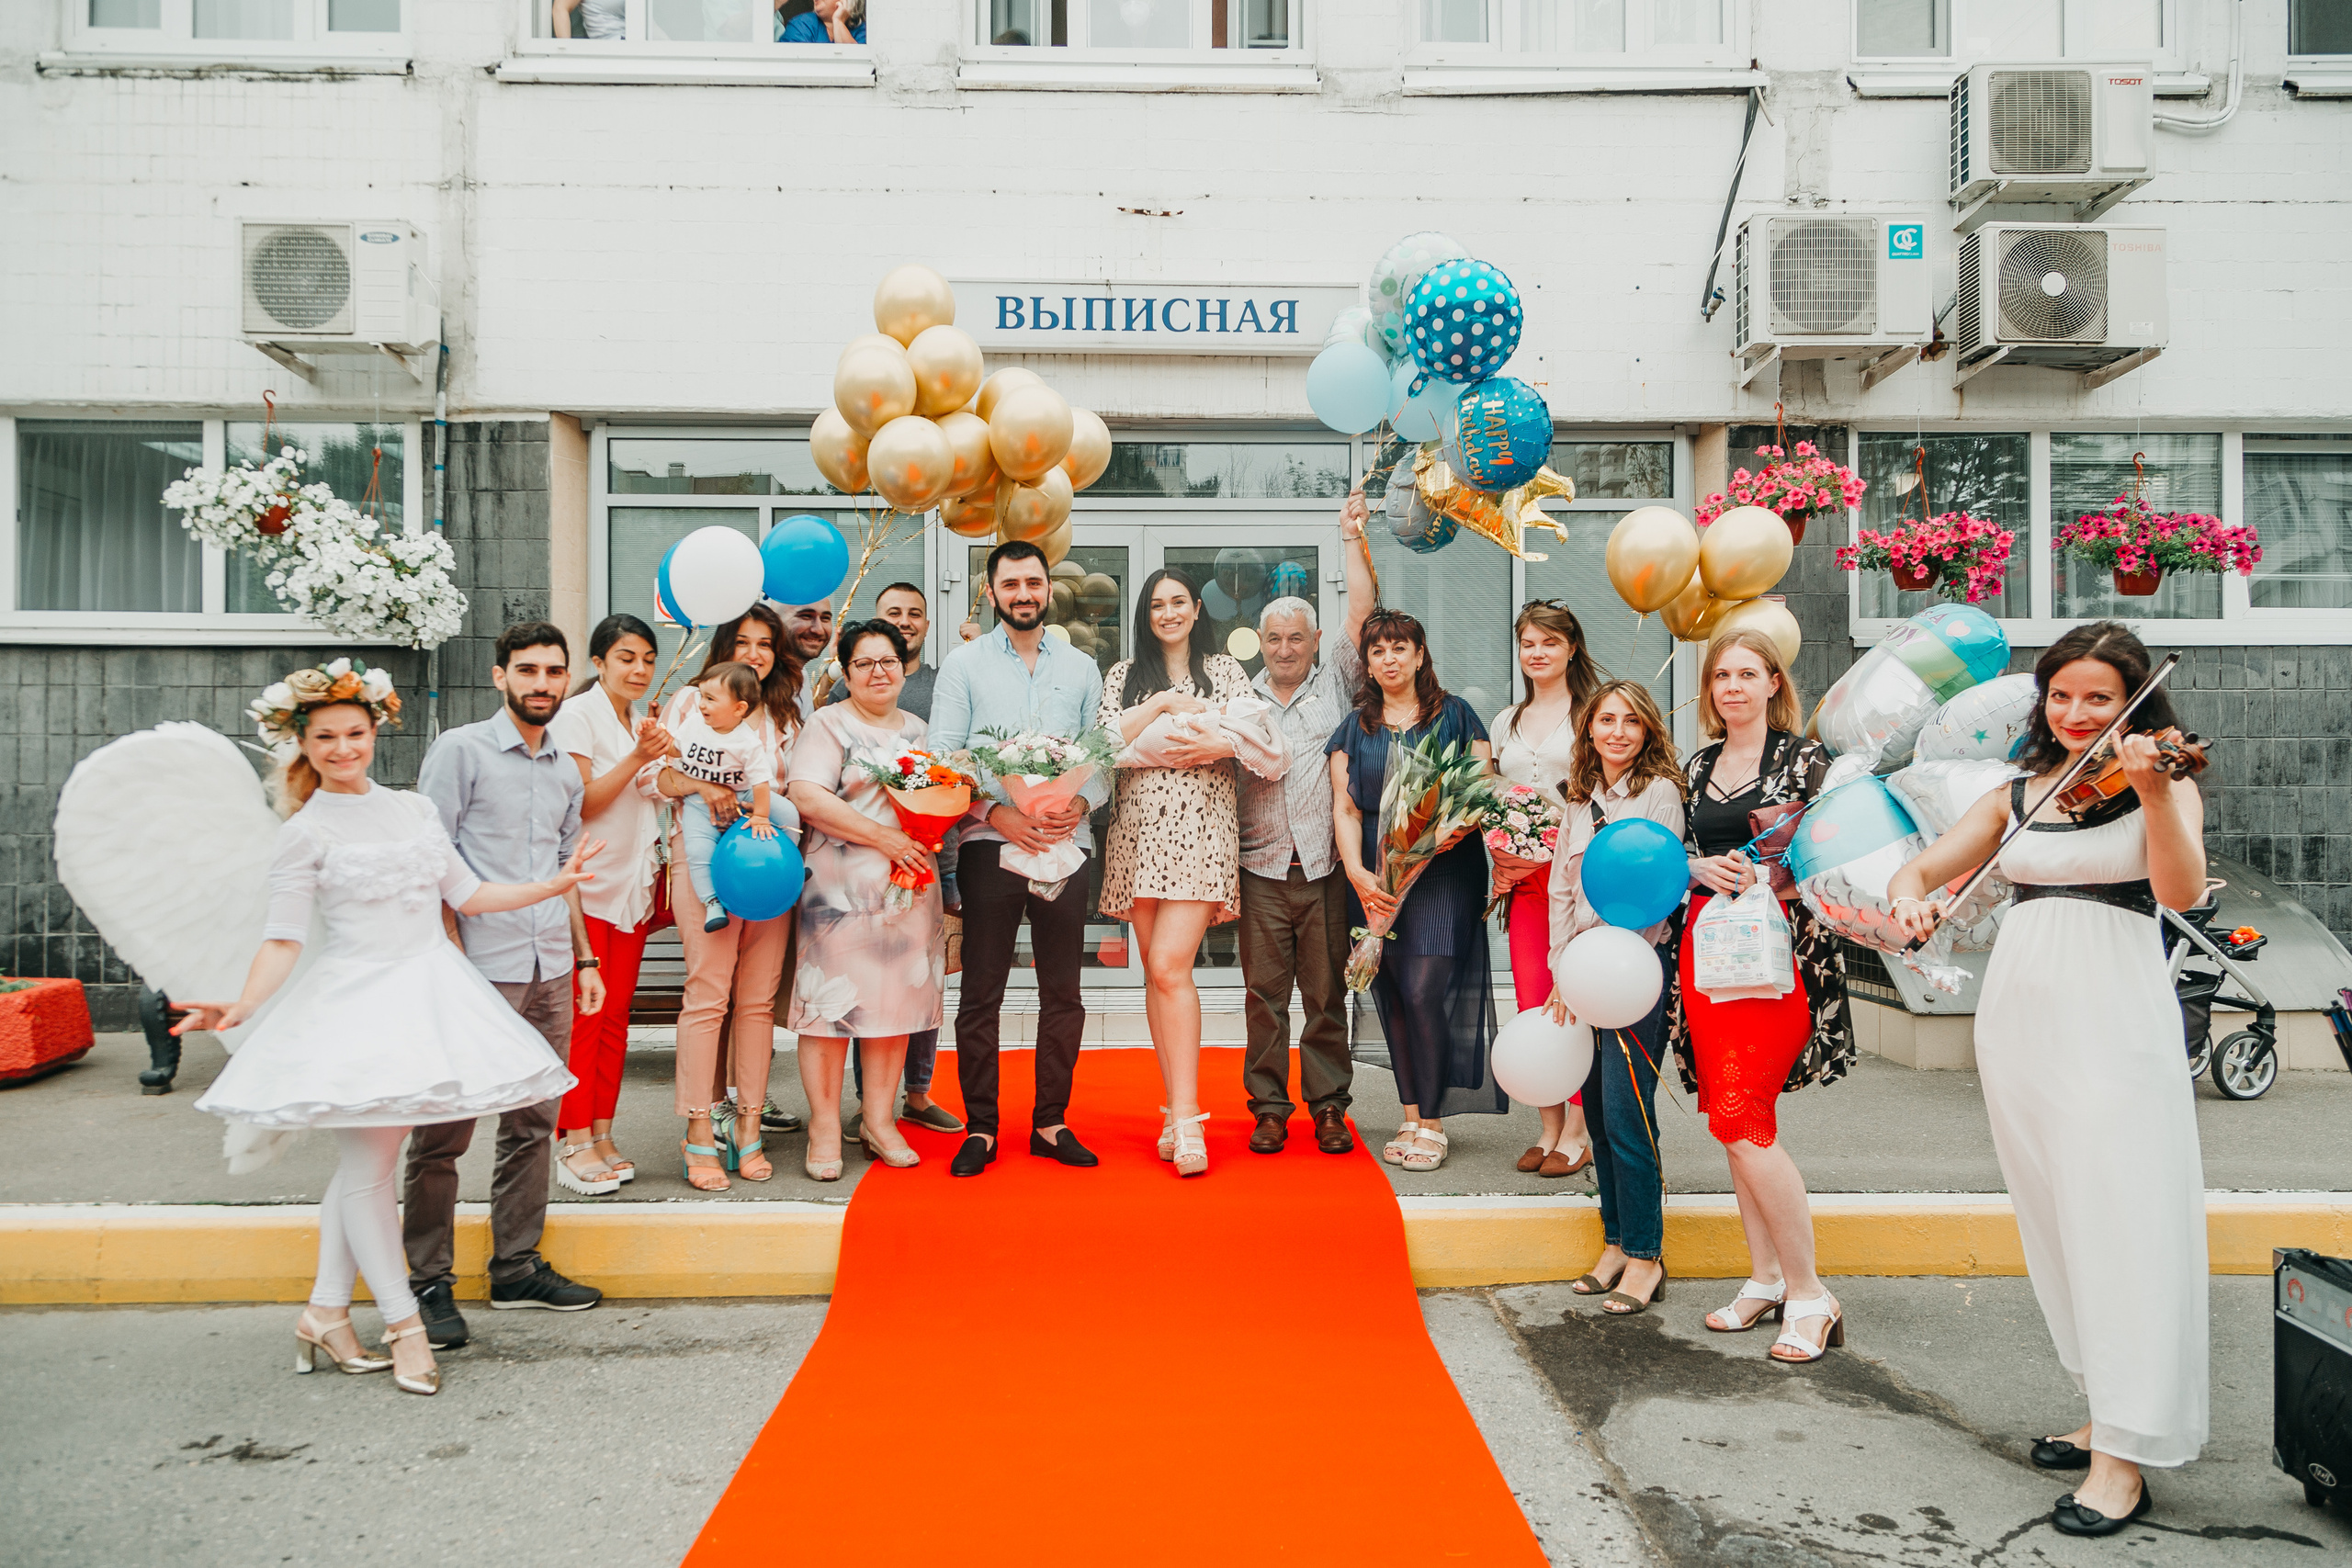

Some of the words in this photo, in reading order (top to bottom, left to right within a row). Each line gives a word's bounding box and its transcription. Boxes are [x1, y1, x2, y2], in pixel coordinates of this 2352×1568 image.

[2108, 77, 2143, 85] TOSOT
[2111, 243, 2162, 253] TOSHIBA
[995, 296, 1300, 333] ВЫПИСНАЯ
[1482, 400, 1514, 465] HAPPY
[1885, 626, 1929, 651] OY
[687, 742, 725, 766] BEST
